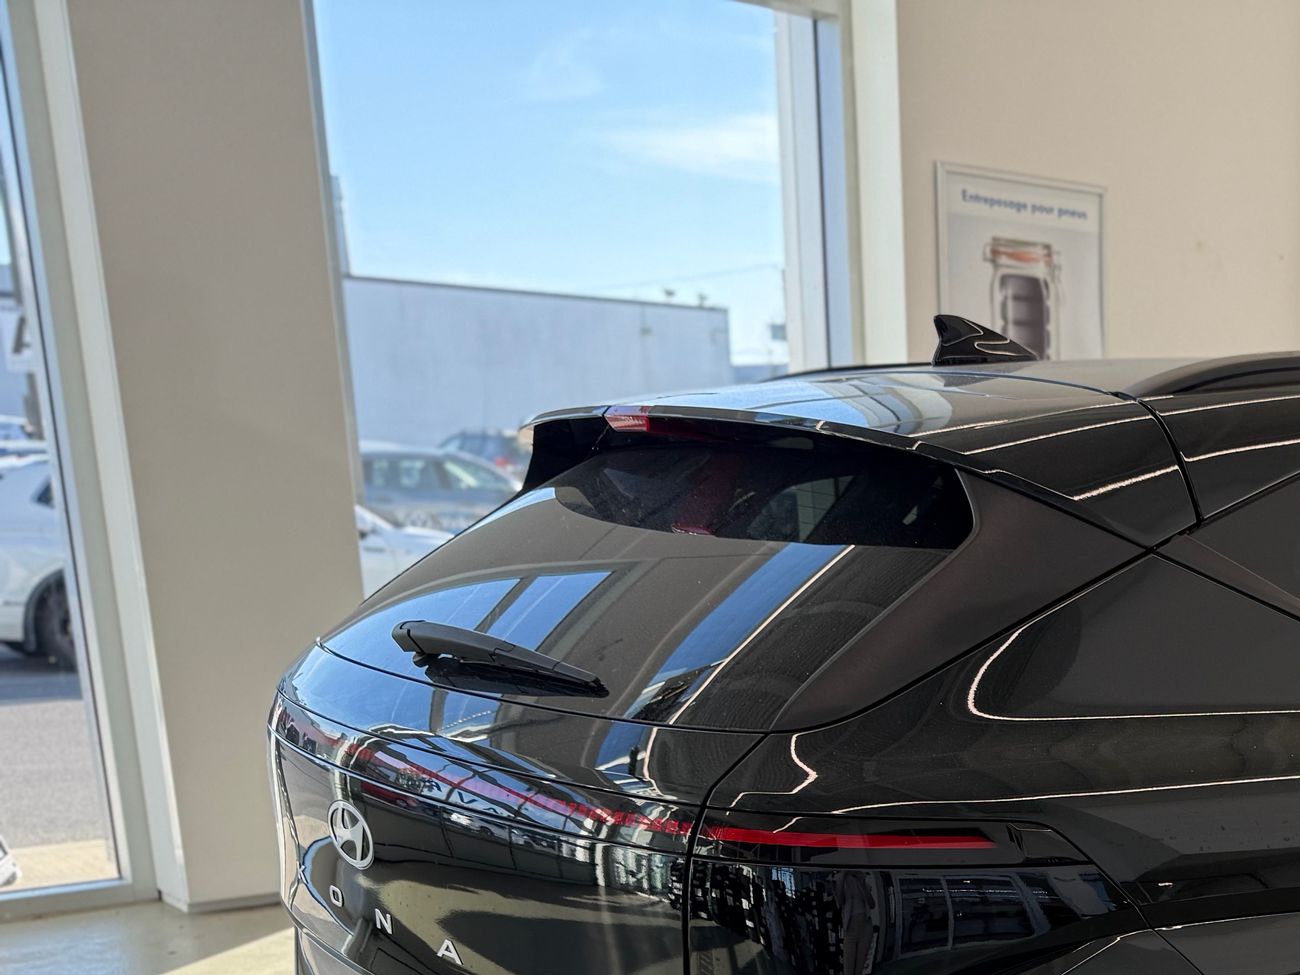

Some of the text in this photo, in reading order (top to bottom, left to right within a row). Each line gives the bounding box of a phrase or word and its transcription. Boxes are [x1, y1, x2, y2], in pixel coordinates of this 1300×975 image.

[961, 188, 1088, 220] Entreposage pour pneus
